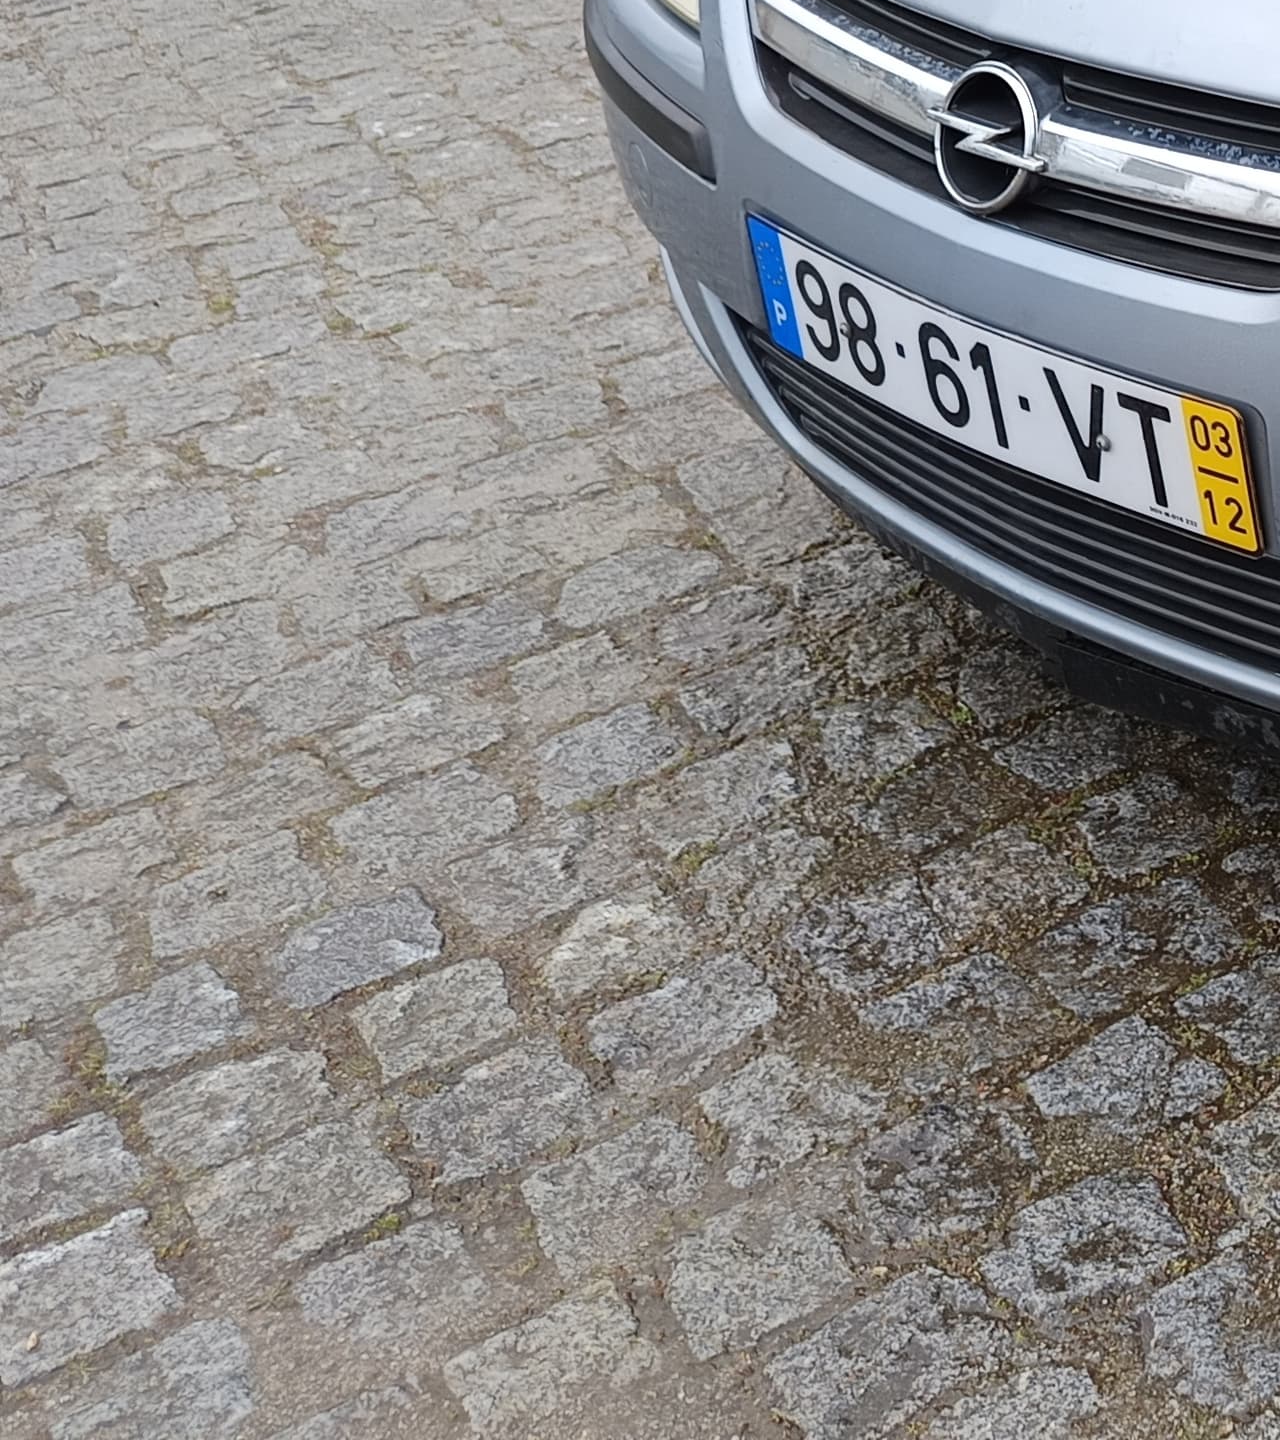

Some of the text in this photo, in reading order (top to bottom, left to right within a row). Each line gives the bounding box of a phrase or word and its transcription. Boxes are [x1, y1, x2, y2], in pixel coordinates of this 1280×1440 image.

[773, 299, 787, 326] P
[1190, 415, 1233, 458] 03
[1204, 489, 1247, 535] 12
